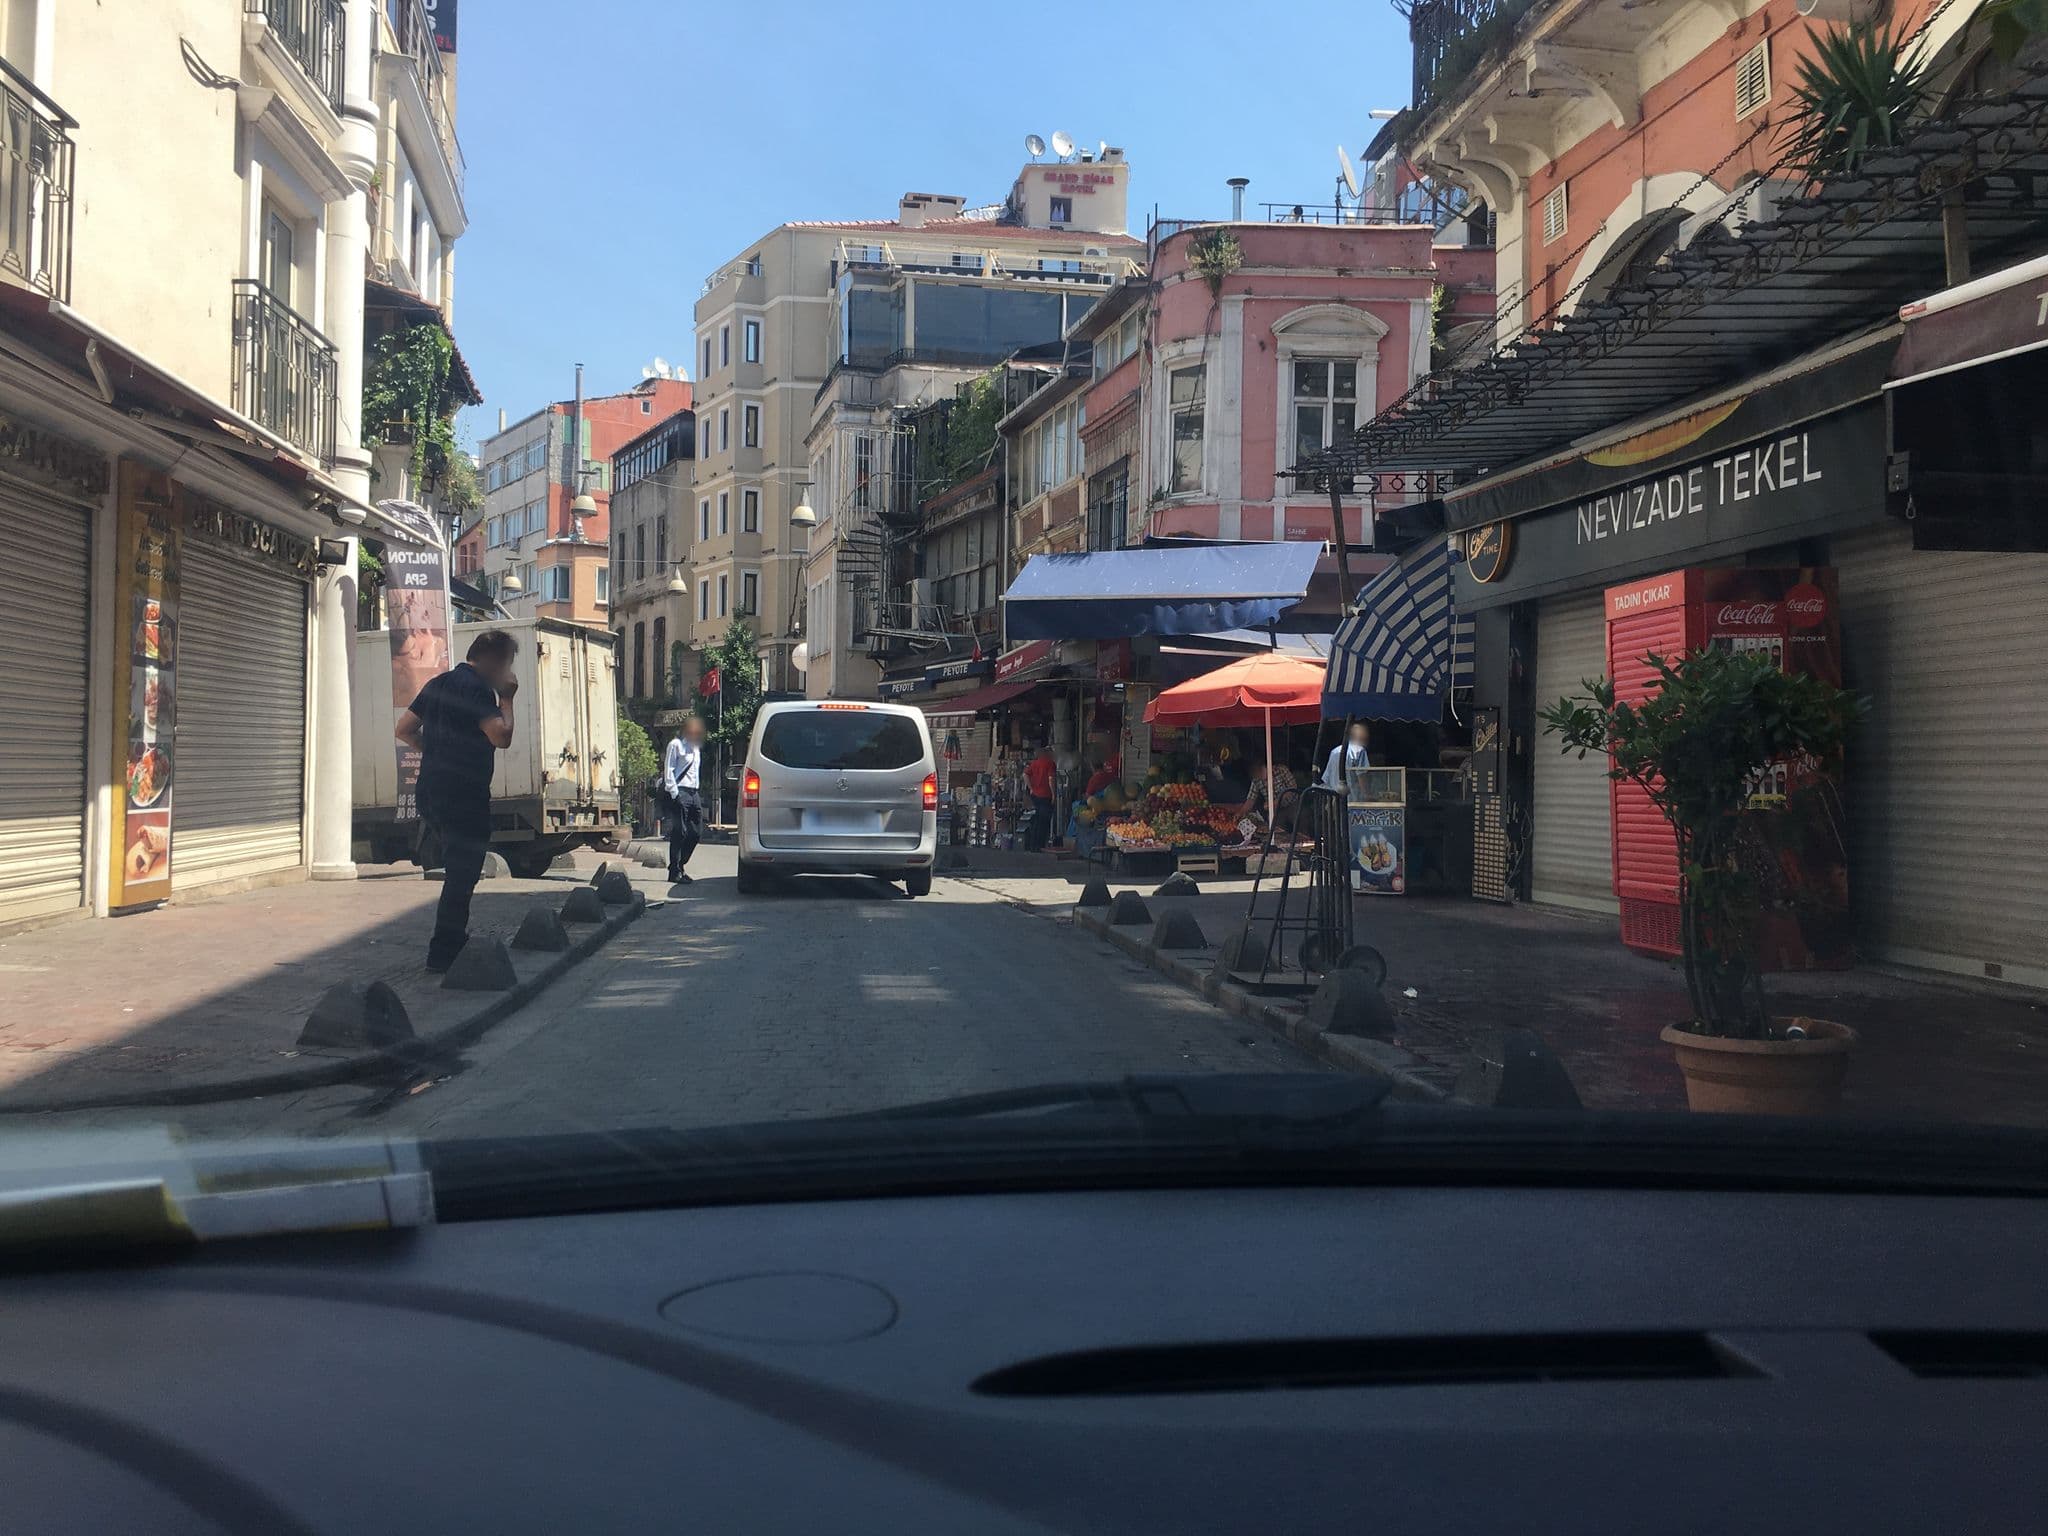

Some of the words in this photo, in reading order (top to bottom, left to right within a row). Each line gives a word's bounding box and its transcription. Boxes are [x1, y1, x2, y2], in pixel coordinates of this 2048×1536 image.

[1712, 432, 1822, 505] TEKEL
[1483, 543, 1500, 556] TIME
[1614, 591, 1641, 611] TADINI
[1717, 603, 1777, 625] Coca-Cola
[942, 664, 969, 677] PEYOTE
[891, 682, 915, 693] PEYOTE
